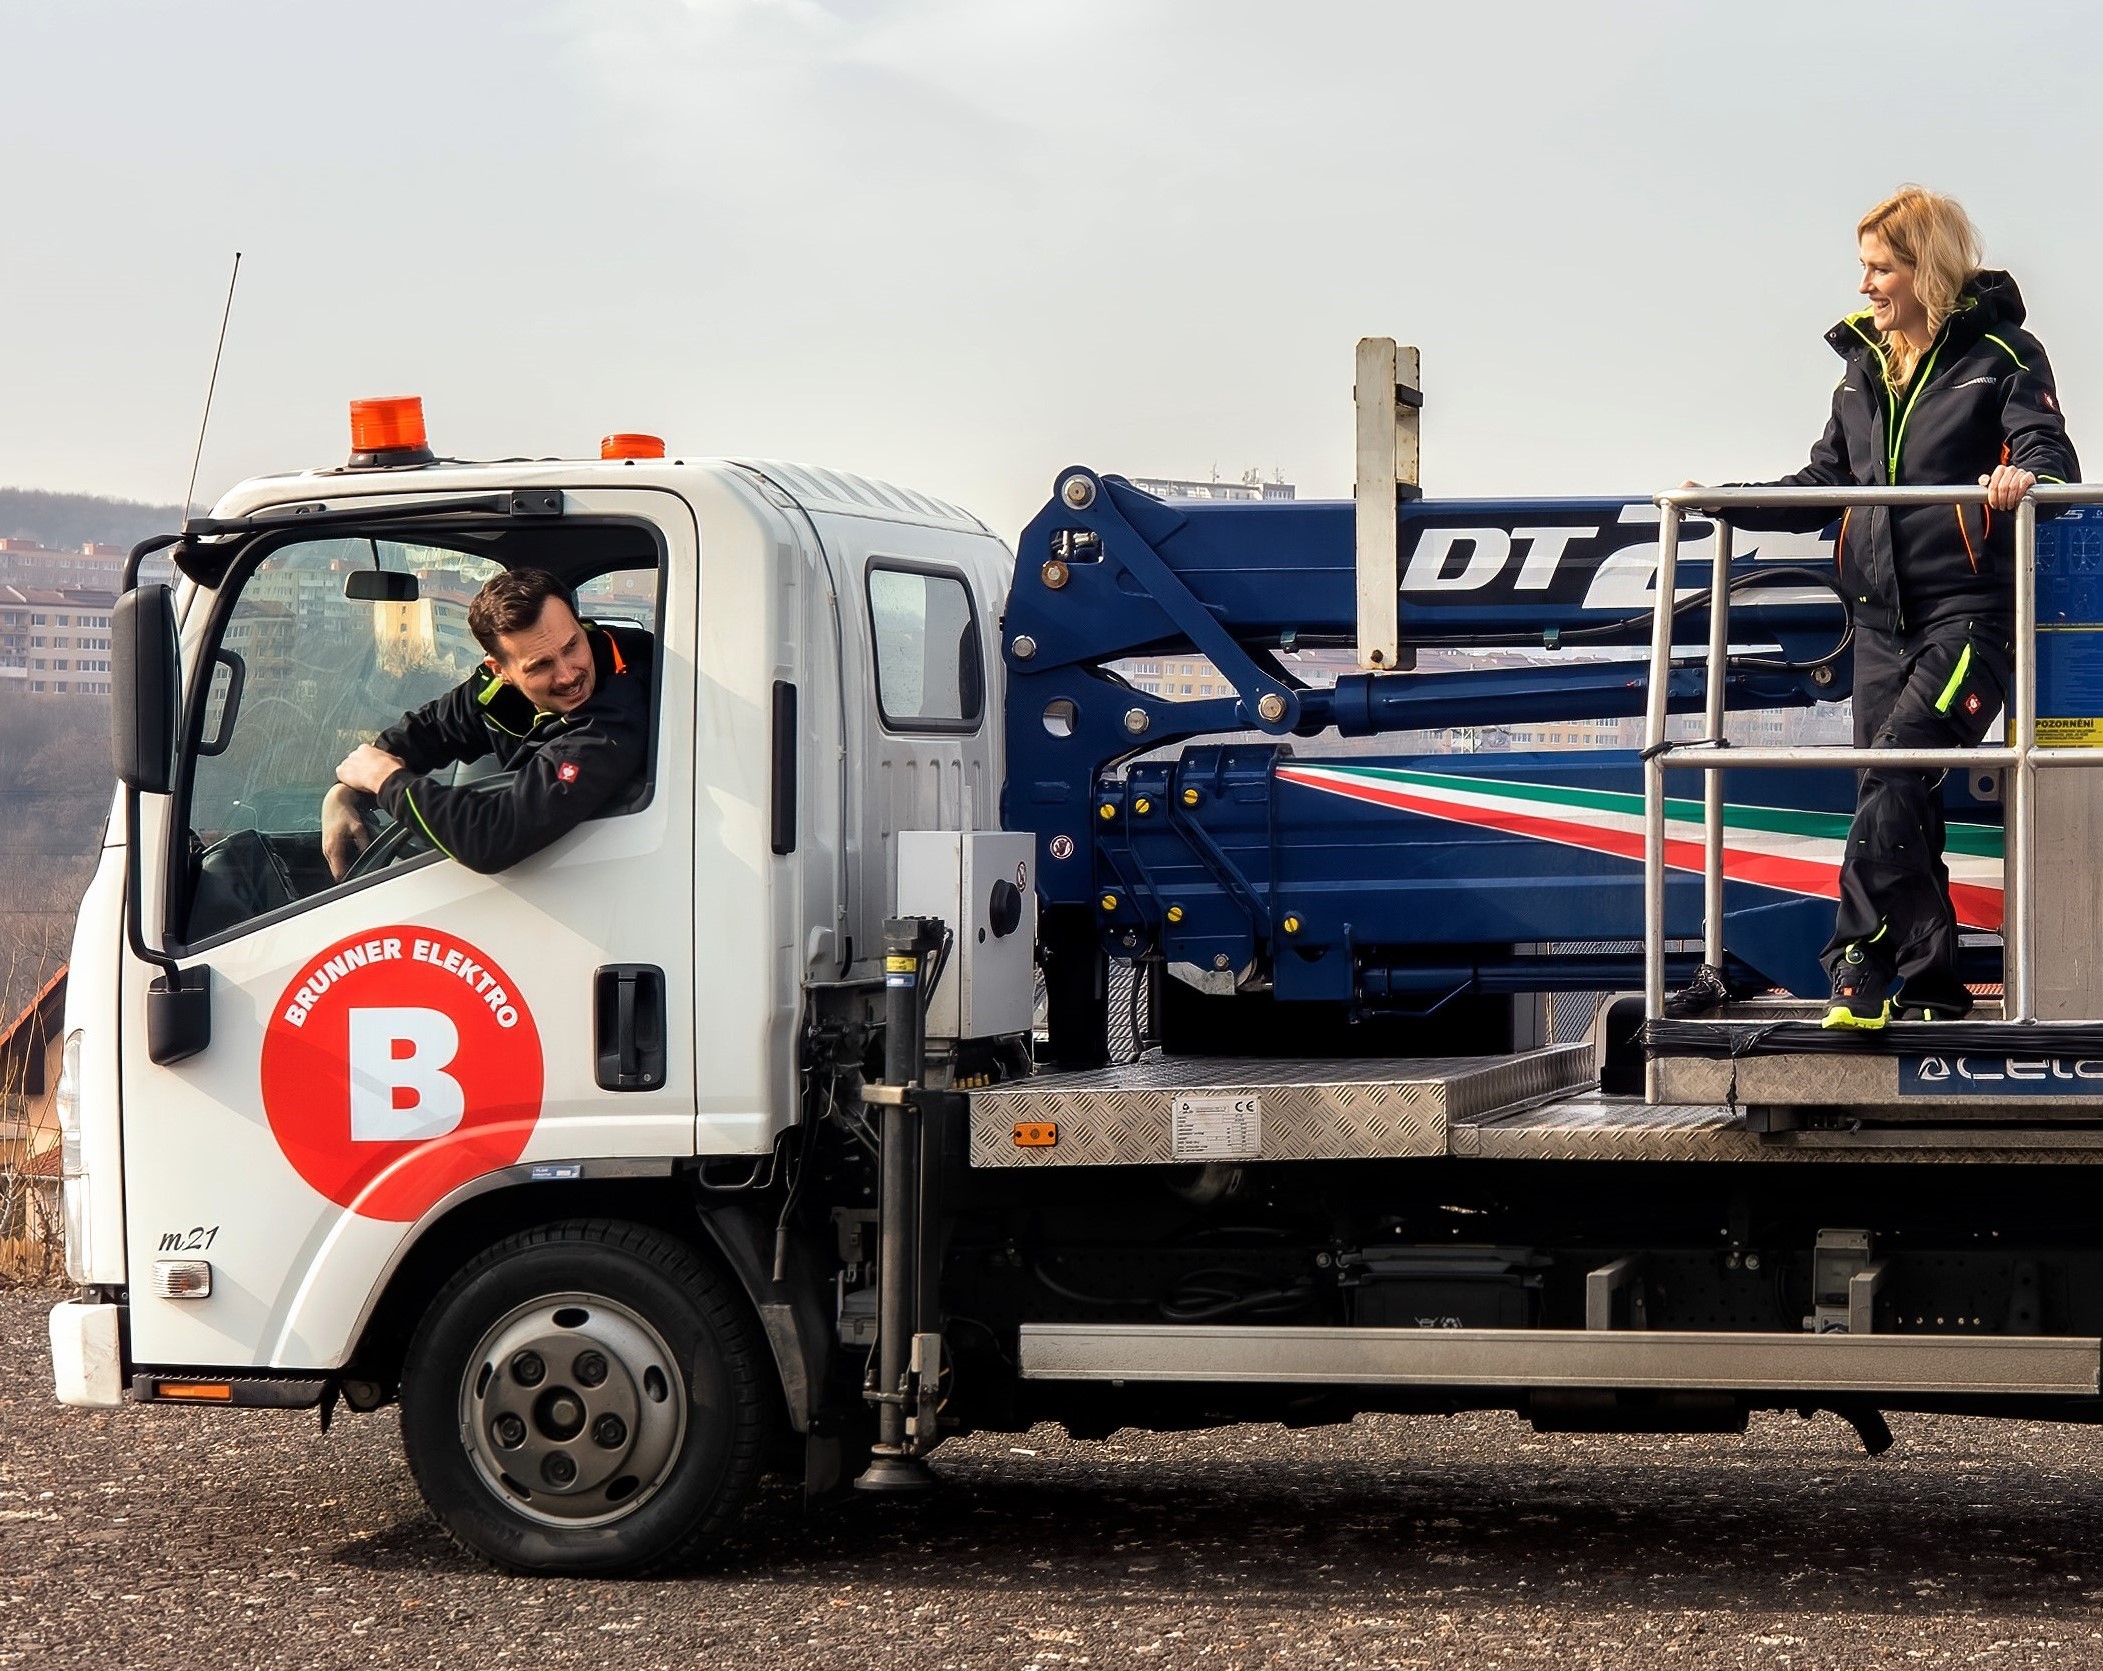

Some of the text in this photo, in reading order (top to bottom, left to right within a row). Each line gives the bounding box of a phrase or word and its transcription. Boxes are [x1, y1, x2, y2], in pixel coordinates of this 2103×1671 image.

[284, 938, 518, 1028] BRUNNER ELEKTRO
[349, 1008, 464, 1141] B
[158, 1225, 220, 1251] m21
